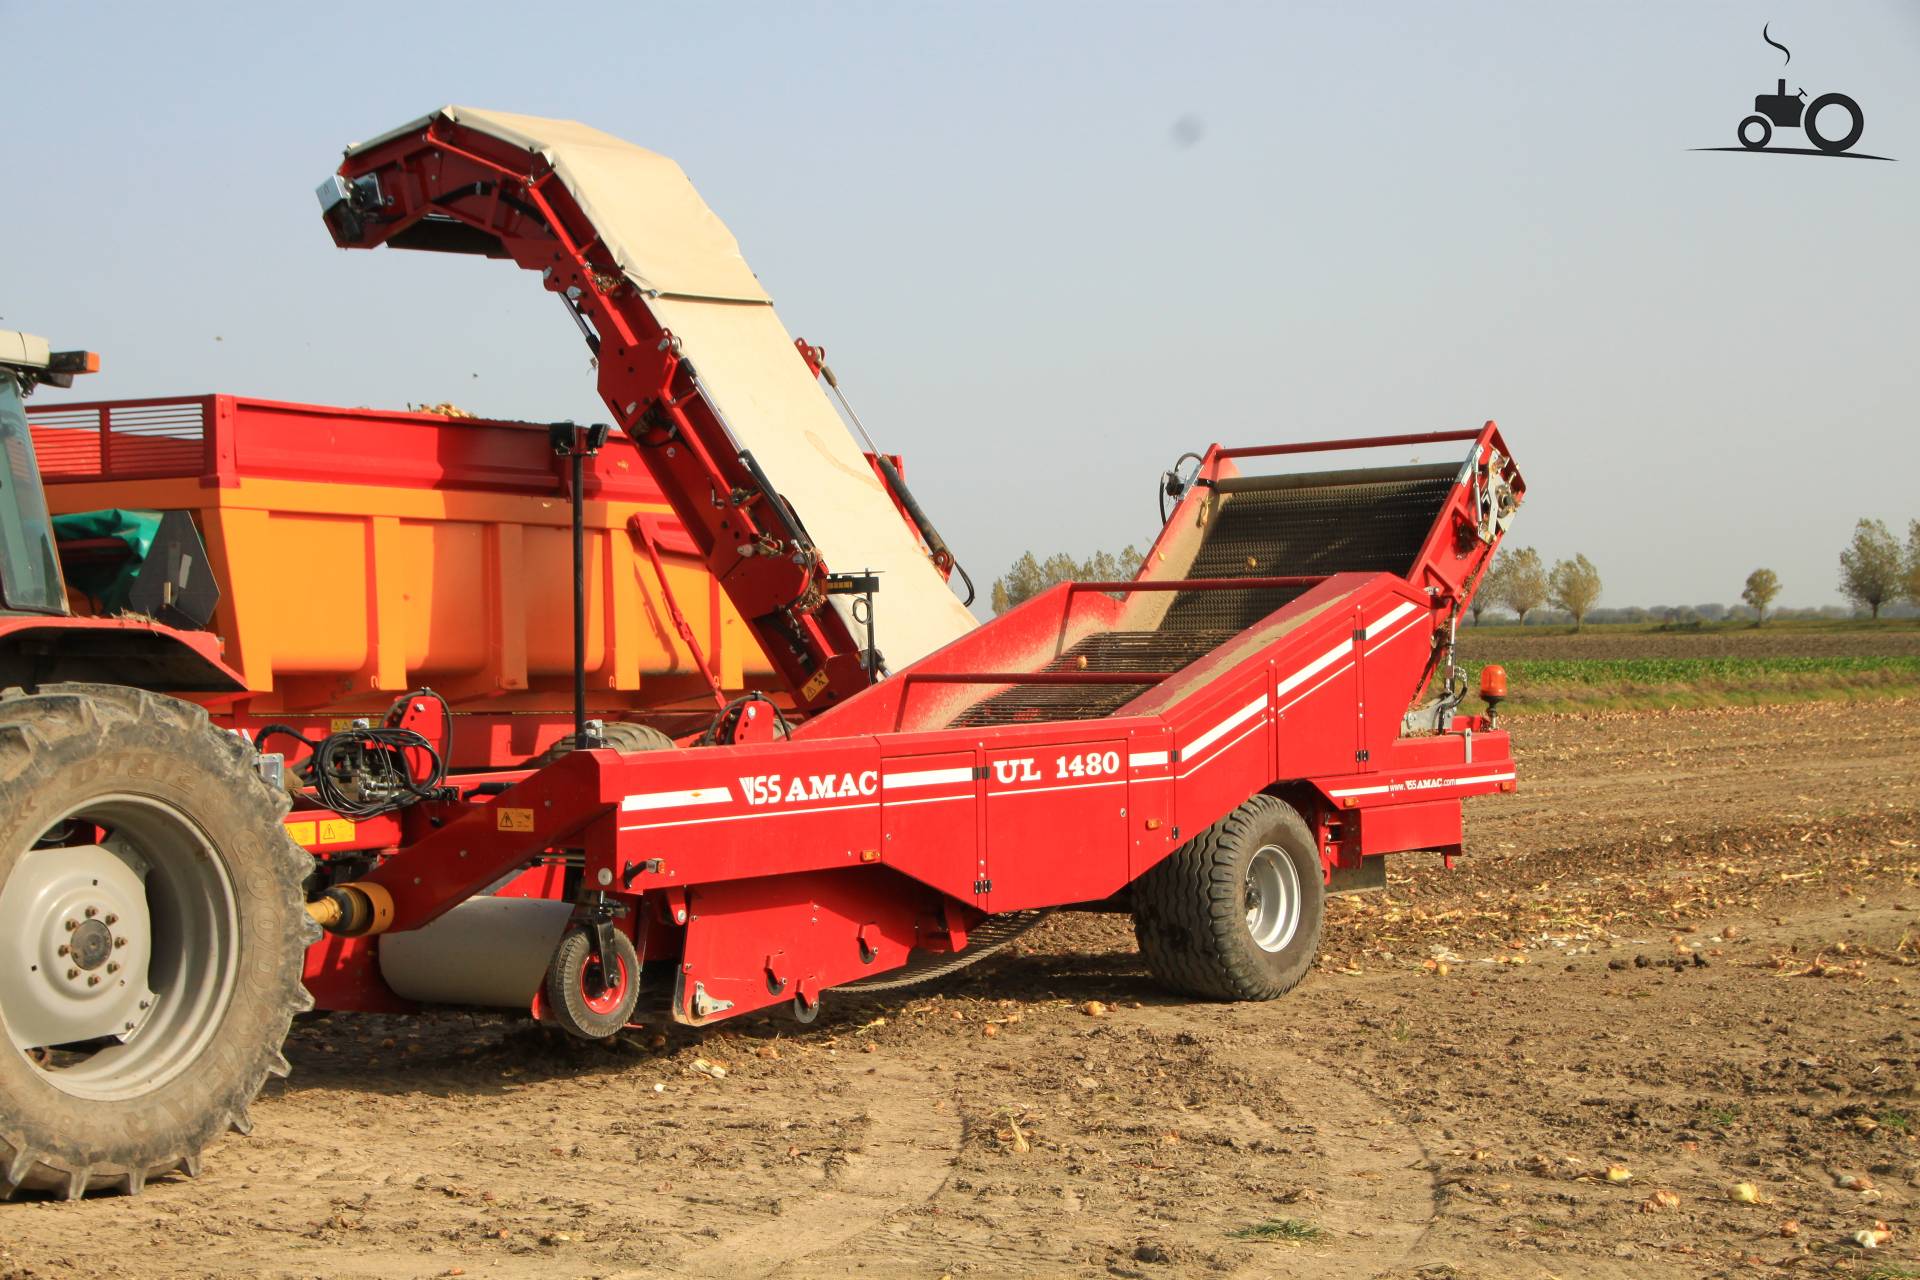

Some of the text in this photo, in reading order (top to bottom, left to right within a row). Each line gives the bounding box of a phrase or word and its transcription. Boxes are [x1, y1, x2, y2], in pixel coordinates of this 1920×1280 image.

[993, 751, 1120, 783] UL 1480
[785, 770, 878, 803] AMAC
